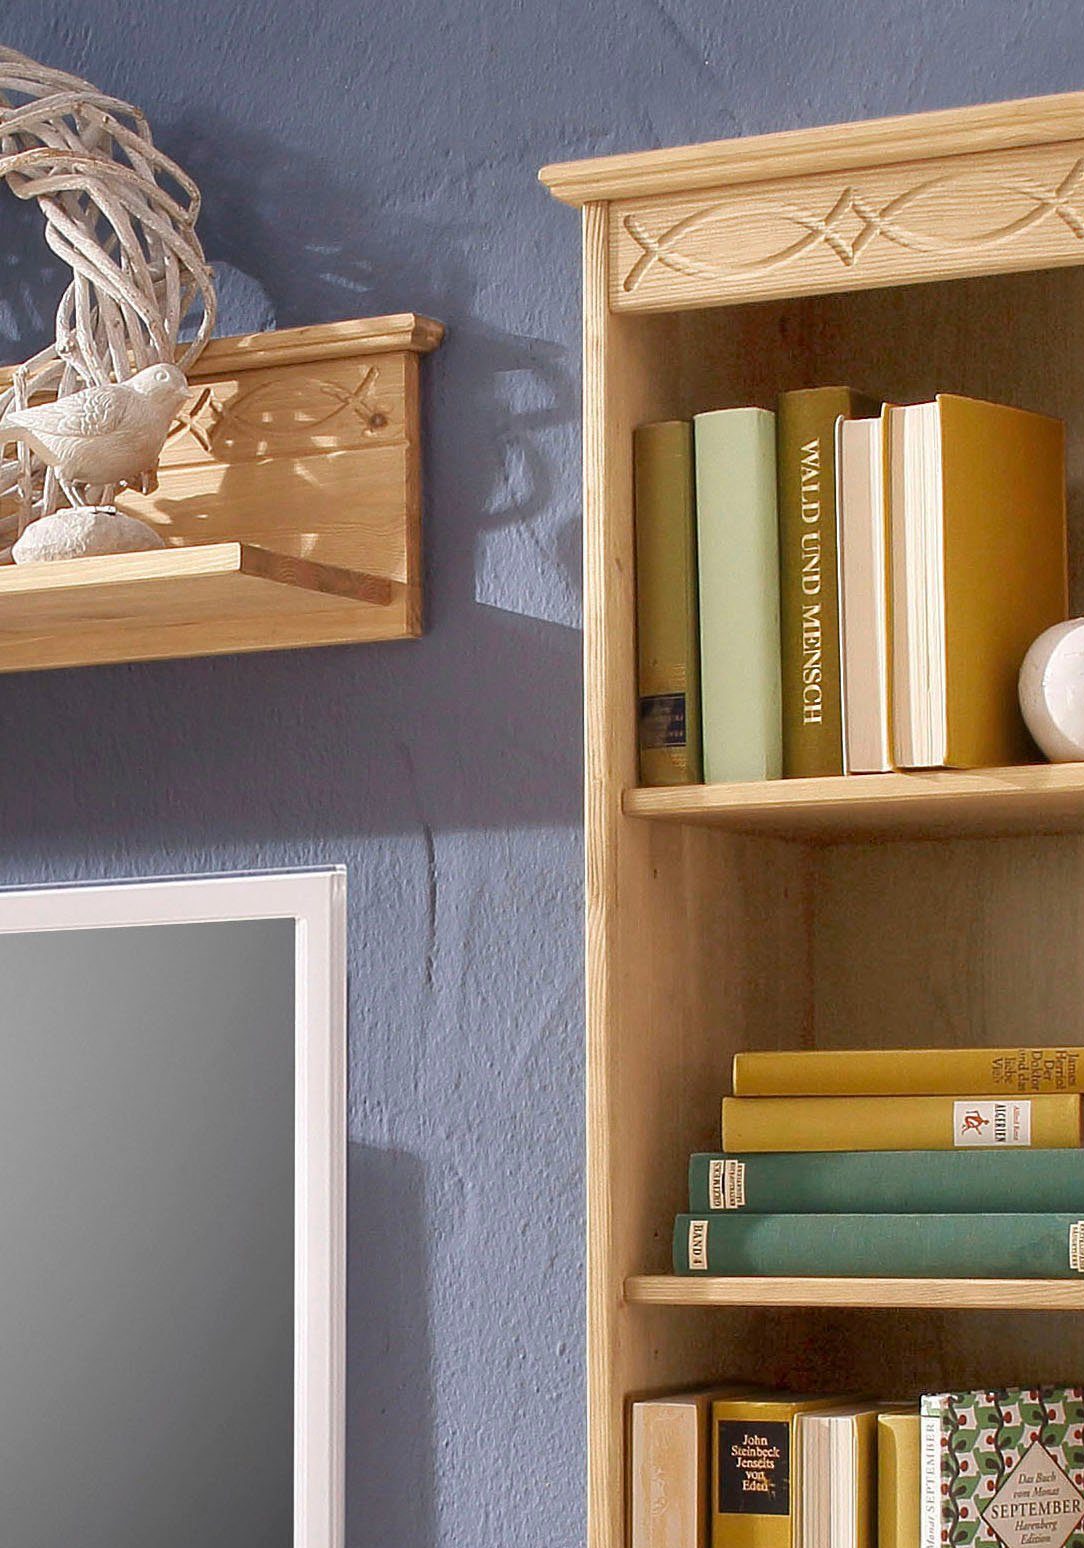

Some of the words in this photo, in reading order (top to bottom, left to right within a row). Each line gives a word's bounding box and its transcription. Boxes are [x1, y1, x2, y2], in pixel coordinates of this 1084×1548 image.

[800, 437, 821, 524] WALD
[801, 532, 821, 595] UND
[802, 604, 823, 726] MENSCH
[994, 1104, 1007, 1142] ALGERIEN
[693, 1225, 704, 1256] BAND
[743, 1434, 768, 1445] John
[731, 1445, 780, 1457] Steinbeck
[736, 1457, 775, 1469] Jenseits
[926, 1423, 935, 1513] SEPTEMBER
[745, 1471, 766, 1480] von
[1018, 1473, 1034, 1484] Das
[1035, 1472, 1057, 1483] Buch
[742, 1480, 768, 1491] Eden
[1013, 1490, 1031, 1499] vom
[1032, 1487, 1060, 1497] Monat
[991, 1499, 1081, 1520] SEPTEMBER
[1015, 1520, 1058, 1532] Harenberg
[1020, 1534, 1052, 1545] Edition
